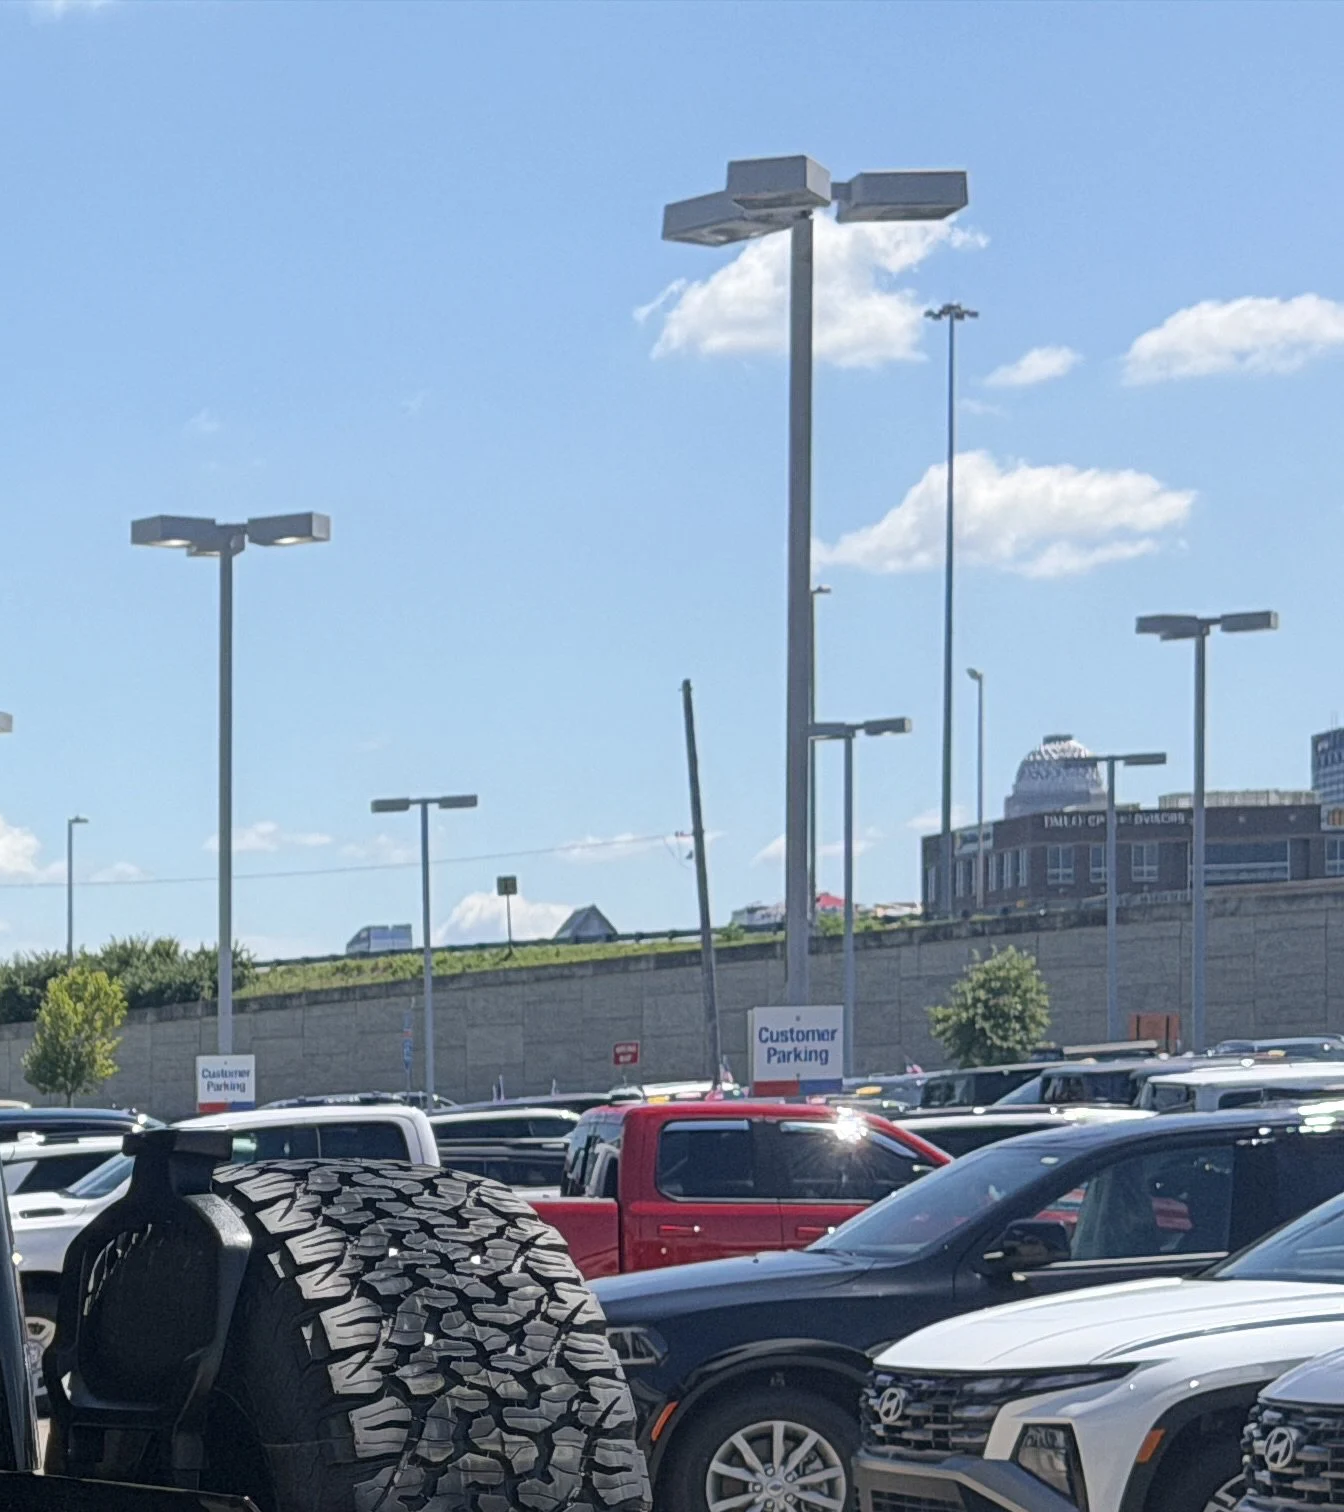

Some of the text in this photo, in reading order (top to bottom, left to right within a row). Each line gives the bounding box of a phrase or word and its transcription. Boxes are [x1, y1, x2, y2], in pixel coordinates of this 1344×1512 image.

[758, 1026, 838, 1043] Customer
[766, 1047, 829, 1066] Parking
[201, 1068, 251, 1079] Customer
[207, 1081, 246, 1094] Parking
